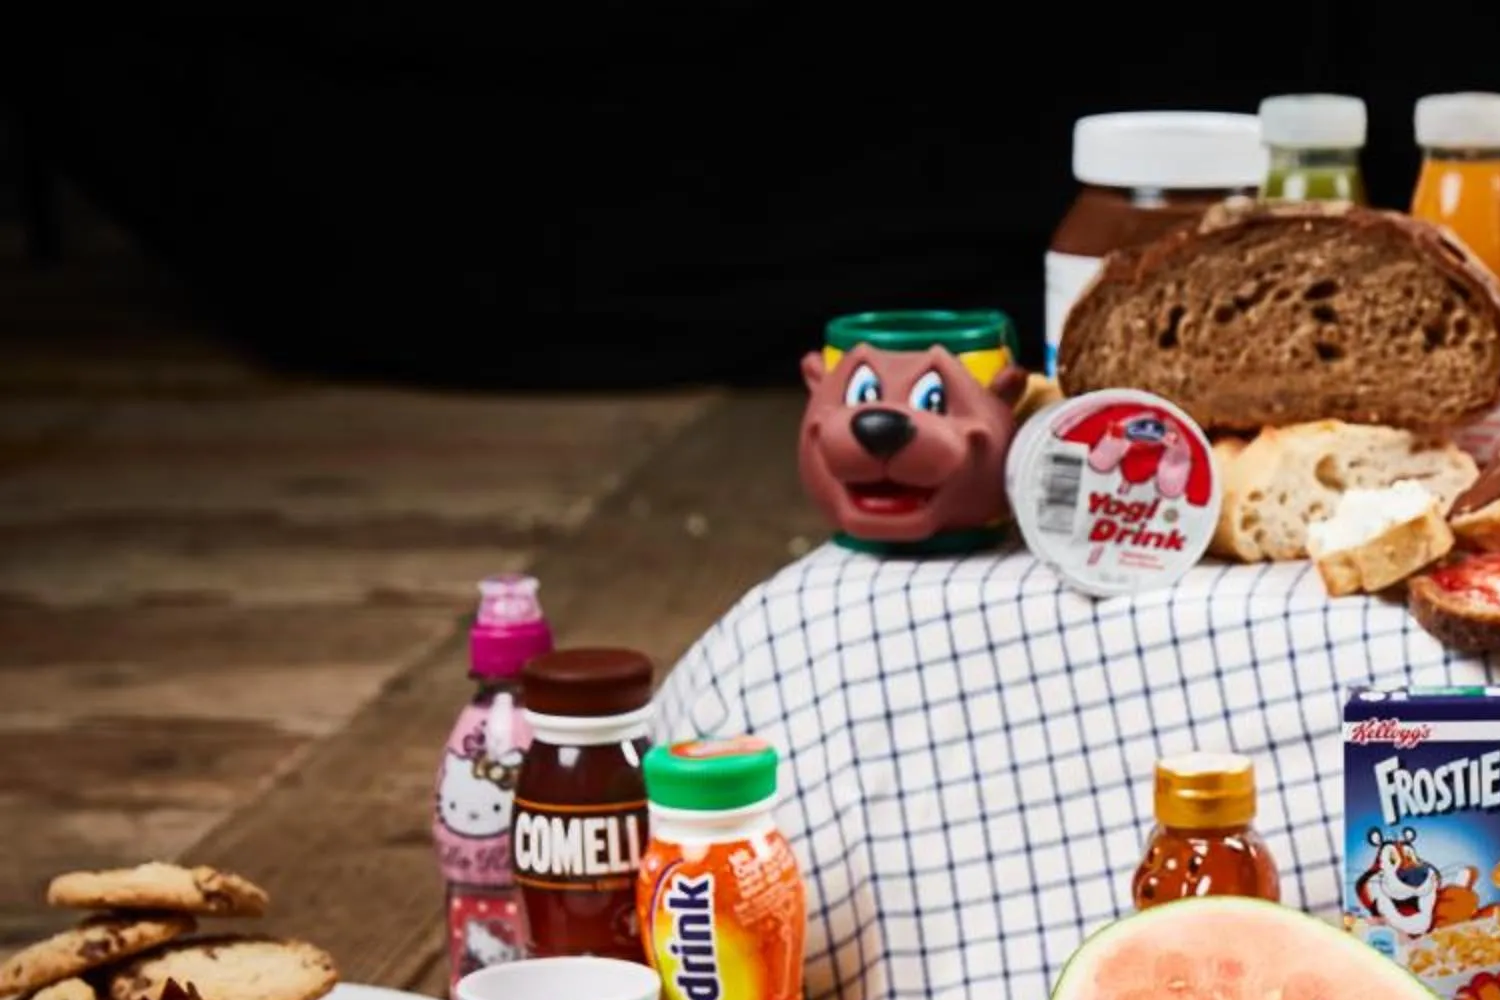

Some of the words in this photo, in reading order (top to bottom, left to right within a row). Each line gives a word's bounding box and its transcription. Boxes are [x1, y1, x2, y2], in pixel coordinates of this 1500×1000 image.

[1088, 491, 1160, 523] Yogi
[1088, 519, 1186, 551] Drink
[1351, 718, 1434, 748] Kellogg's
